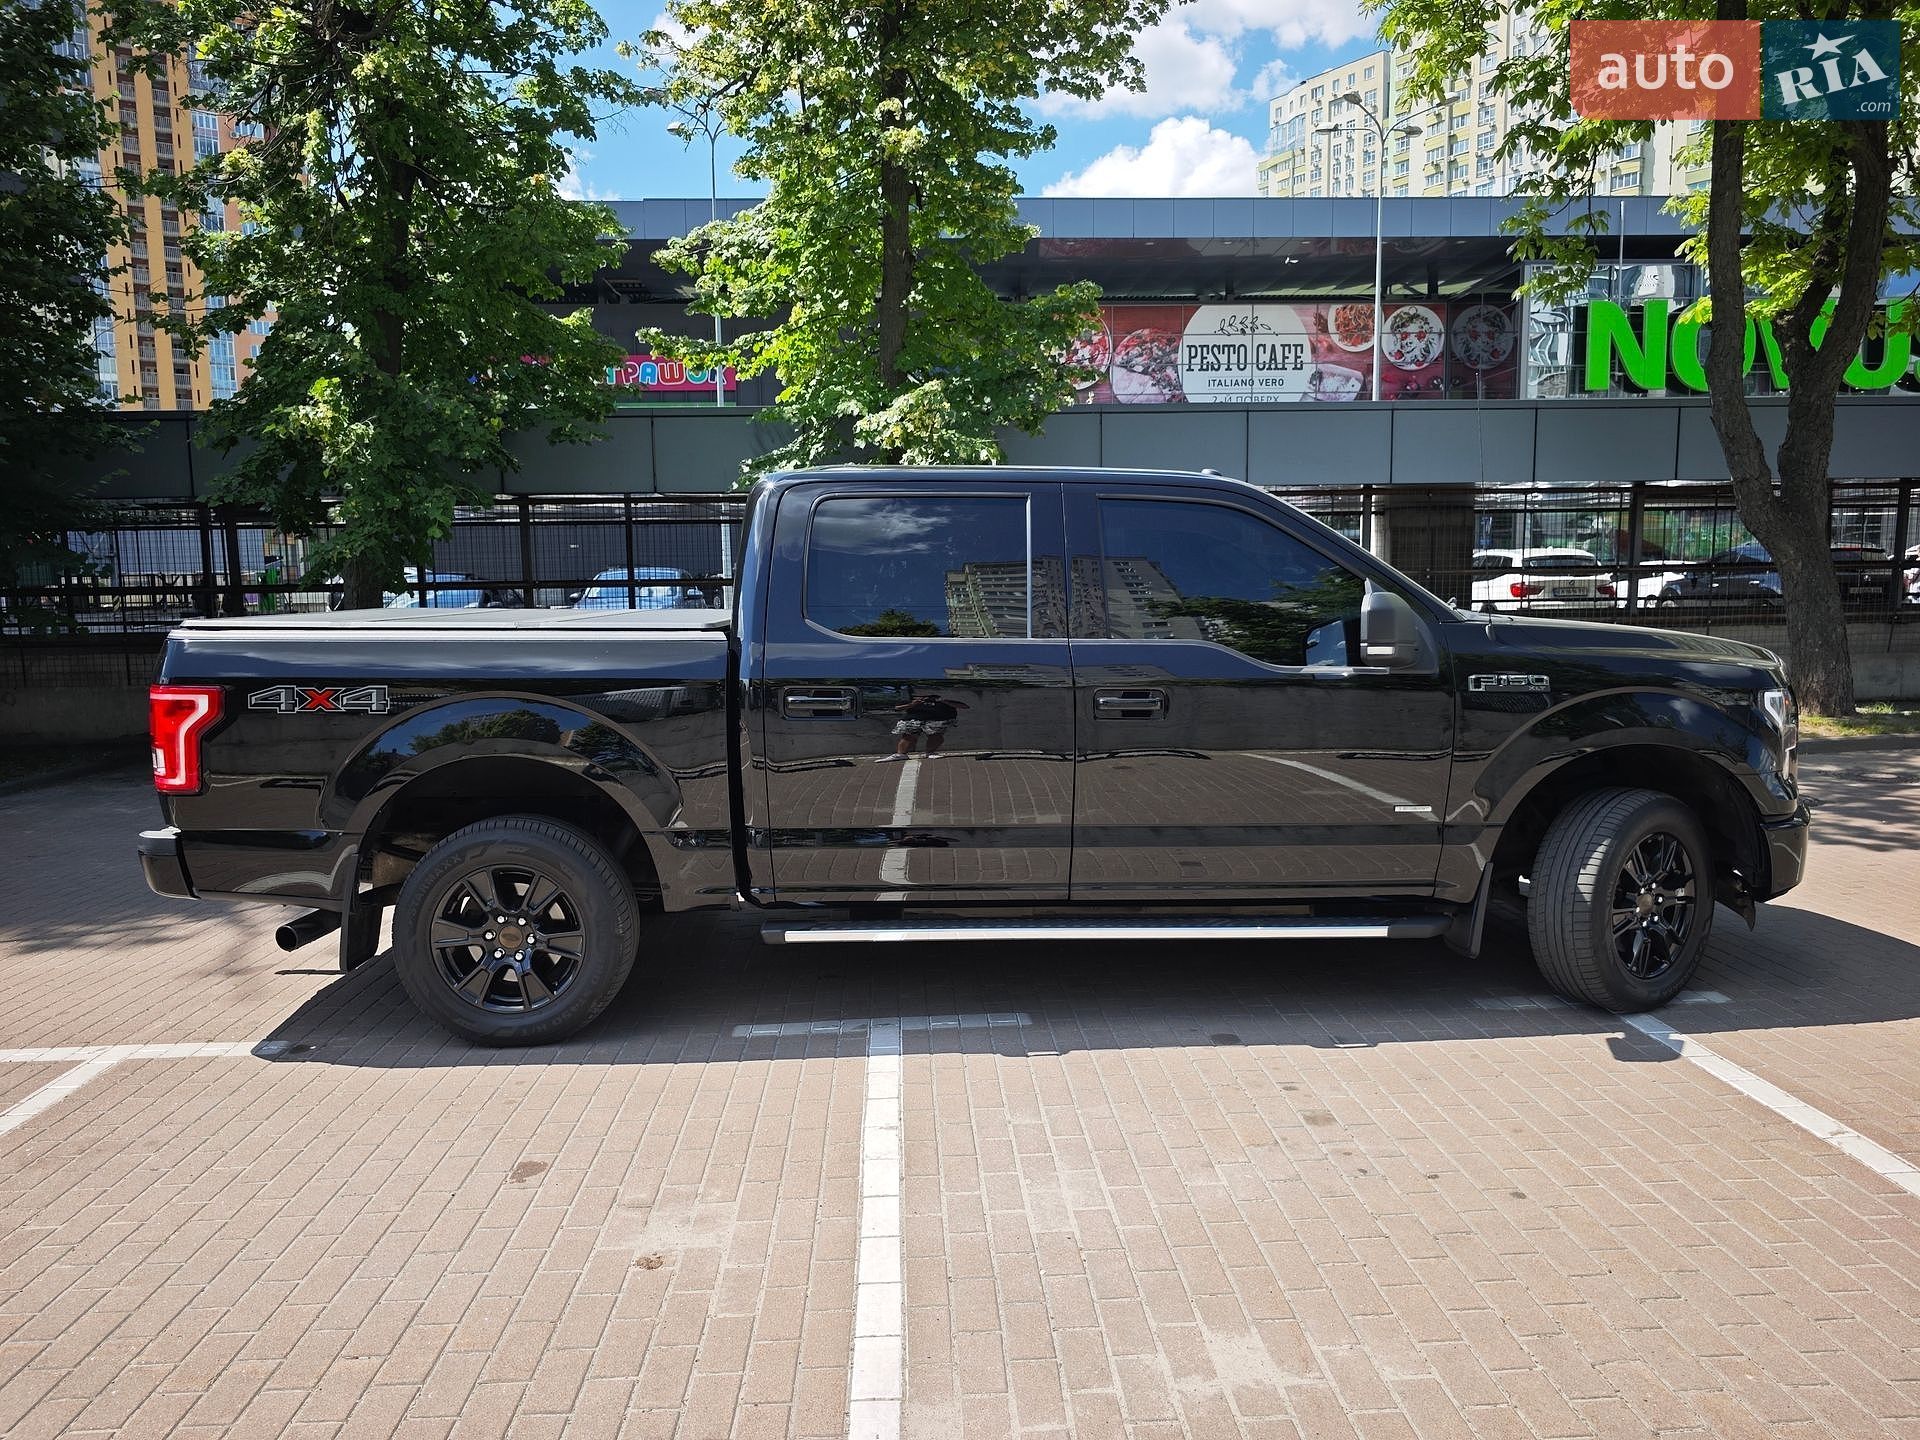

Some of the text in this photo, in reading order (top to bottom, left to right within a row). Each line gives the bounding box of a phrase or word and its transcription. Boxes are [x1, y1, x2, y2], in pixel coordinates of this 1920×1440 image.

[1186, 343, 1304, 372] PESTO CAFE
[1585, 299, 1920, 391] NOVU
[1207, 378, 1285, 388] ITALIANO VERO
